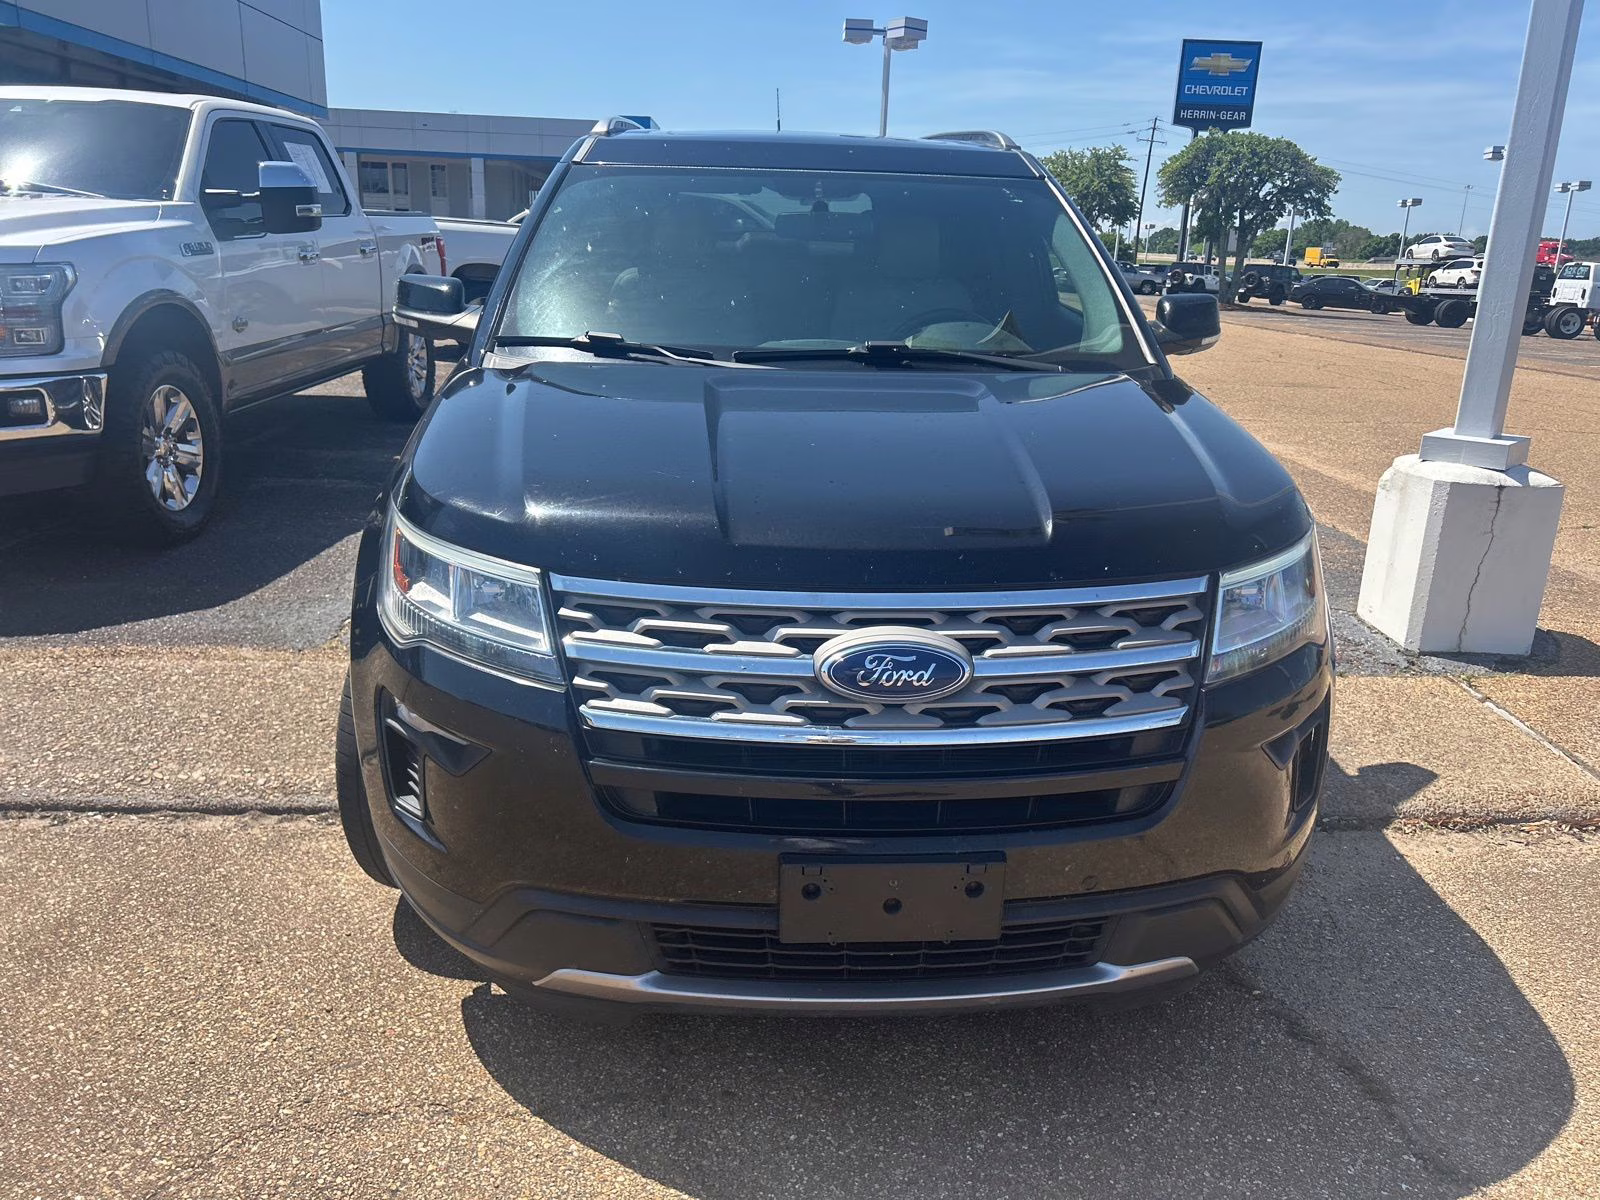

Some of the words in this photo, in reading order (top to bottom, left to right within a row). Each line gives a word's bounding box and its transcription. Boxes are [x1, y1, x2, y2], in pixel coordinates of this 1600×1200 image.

[1184, 84, 1248, 96] CHEVROLET
[1180, 109, 1246, 120] HERRIN-GEAR
[856, 653, 937, 687] Ford
